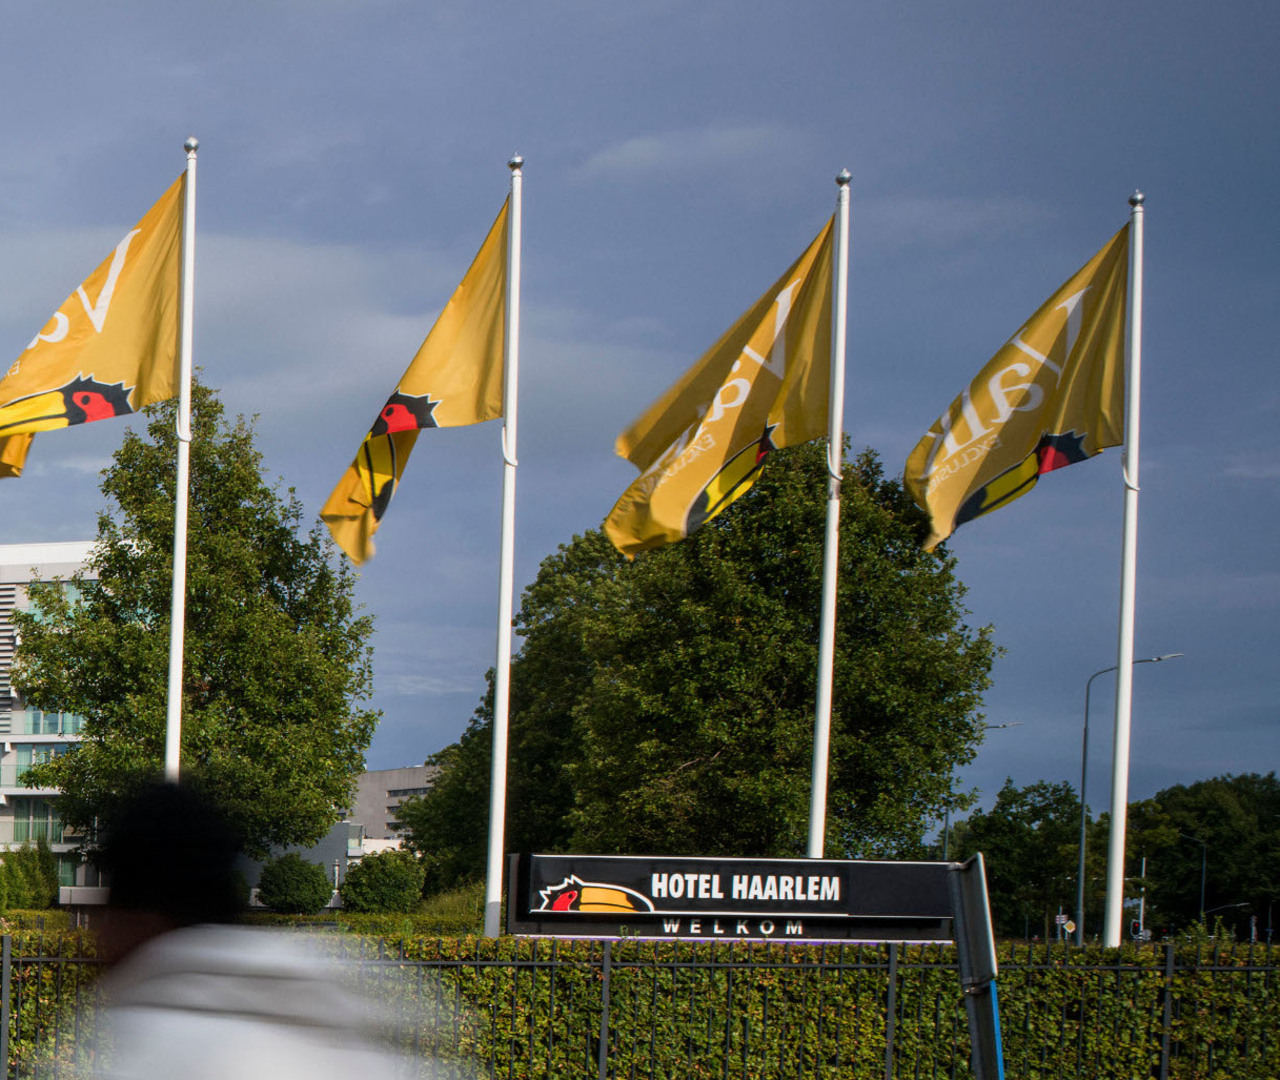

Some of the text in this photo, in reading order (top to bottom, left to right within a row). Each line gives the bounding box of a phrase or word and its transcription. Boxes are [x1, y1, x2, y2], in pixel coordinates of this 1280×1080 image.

[651, 873, 840, 901] HOTEL HAARLEM
[662, 918, 803, 935] WELKOM
